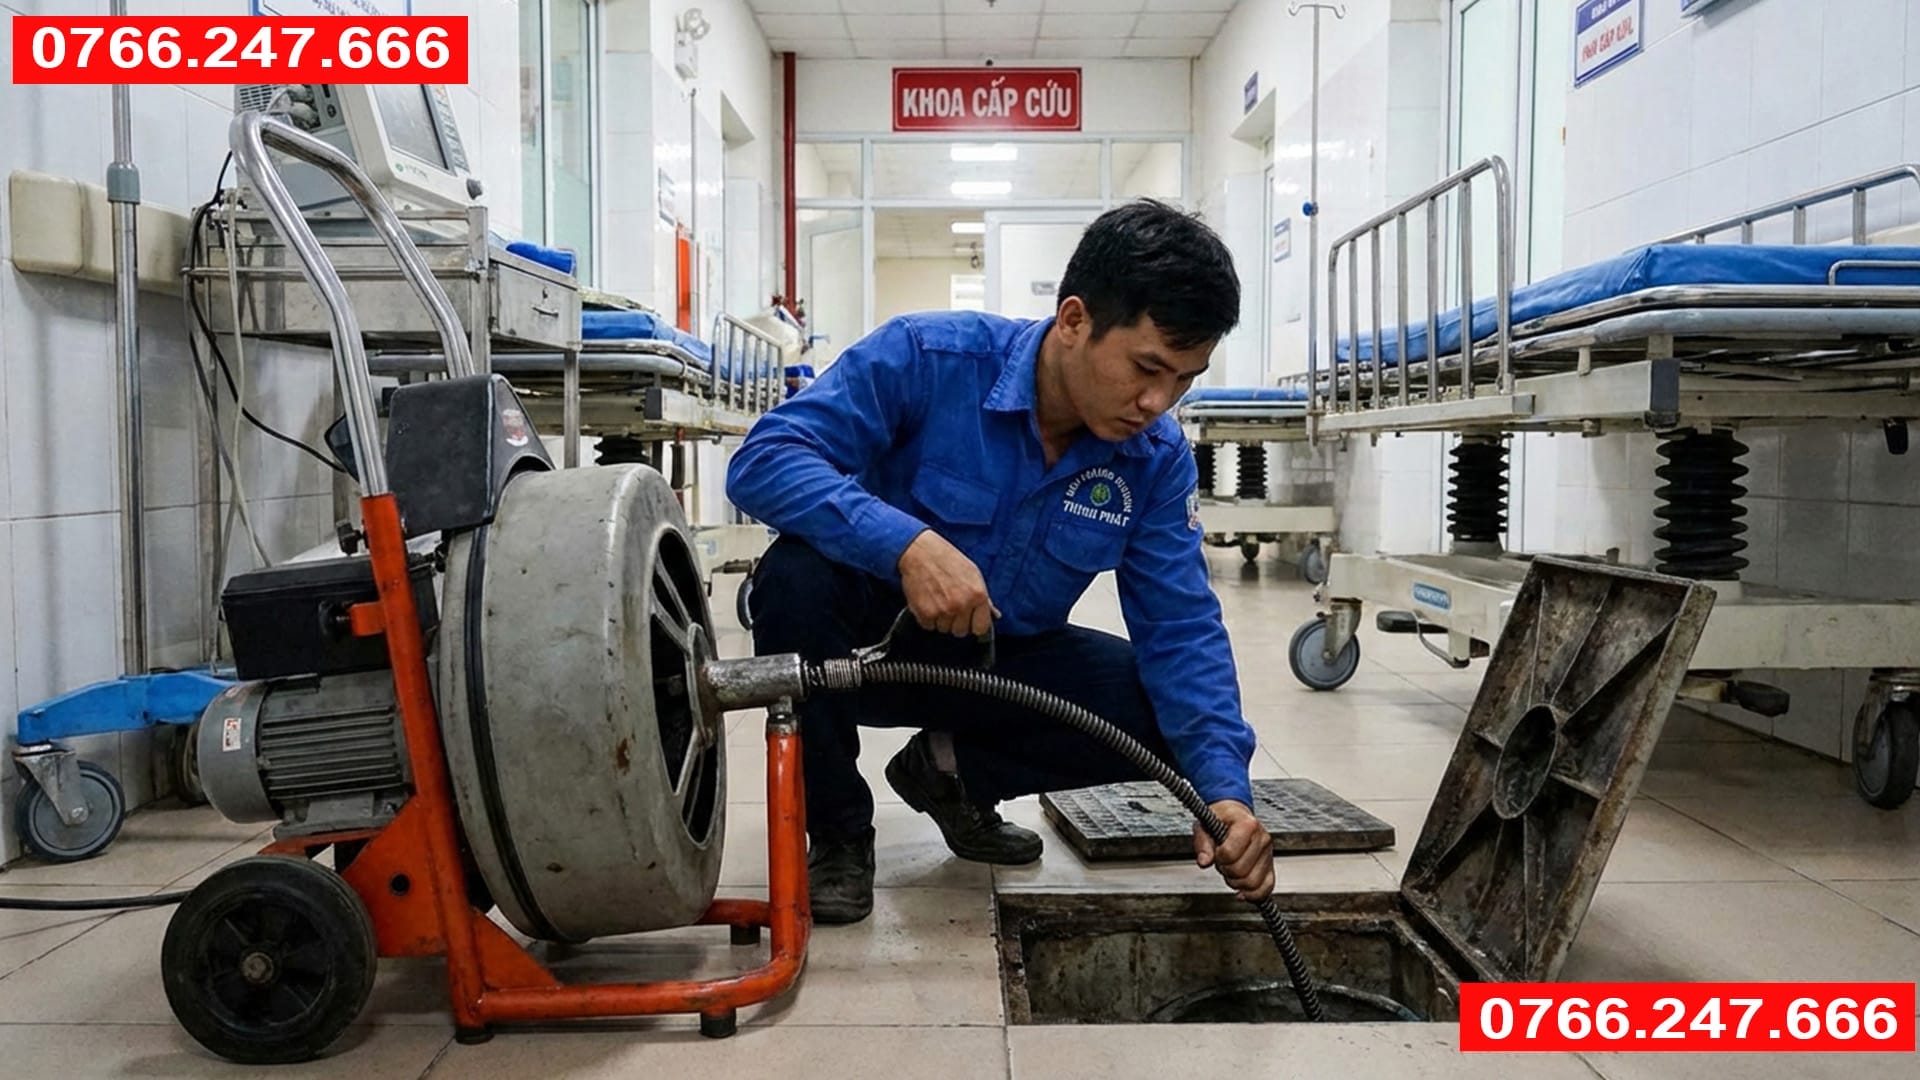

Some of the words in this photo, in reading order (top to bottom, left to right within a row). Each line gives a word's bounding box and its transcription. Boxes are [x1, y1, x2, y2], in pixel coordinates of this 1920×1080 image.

[902, 87, 966, 118] KHOA
[972, 76, 1018, 118] CẤP
[1025, 79, 1072, 118] CỨU
